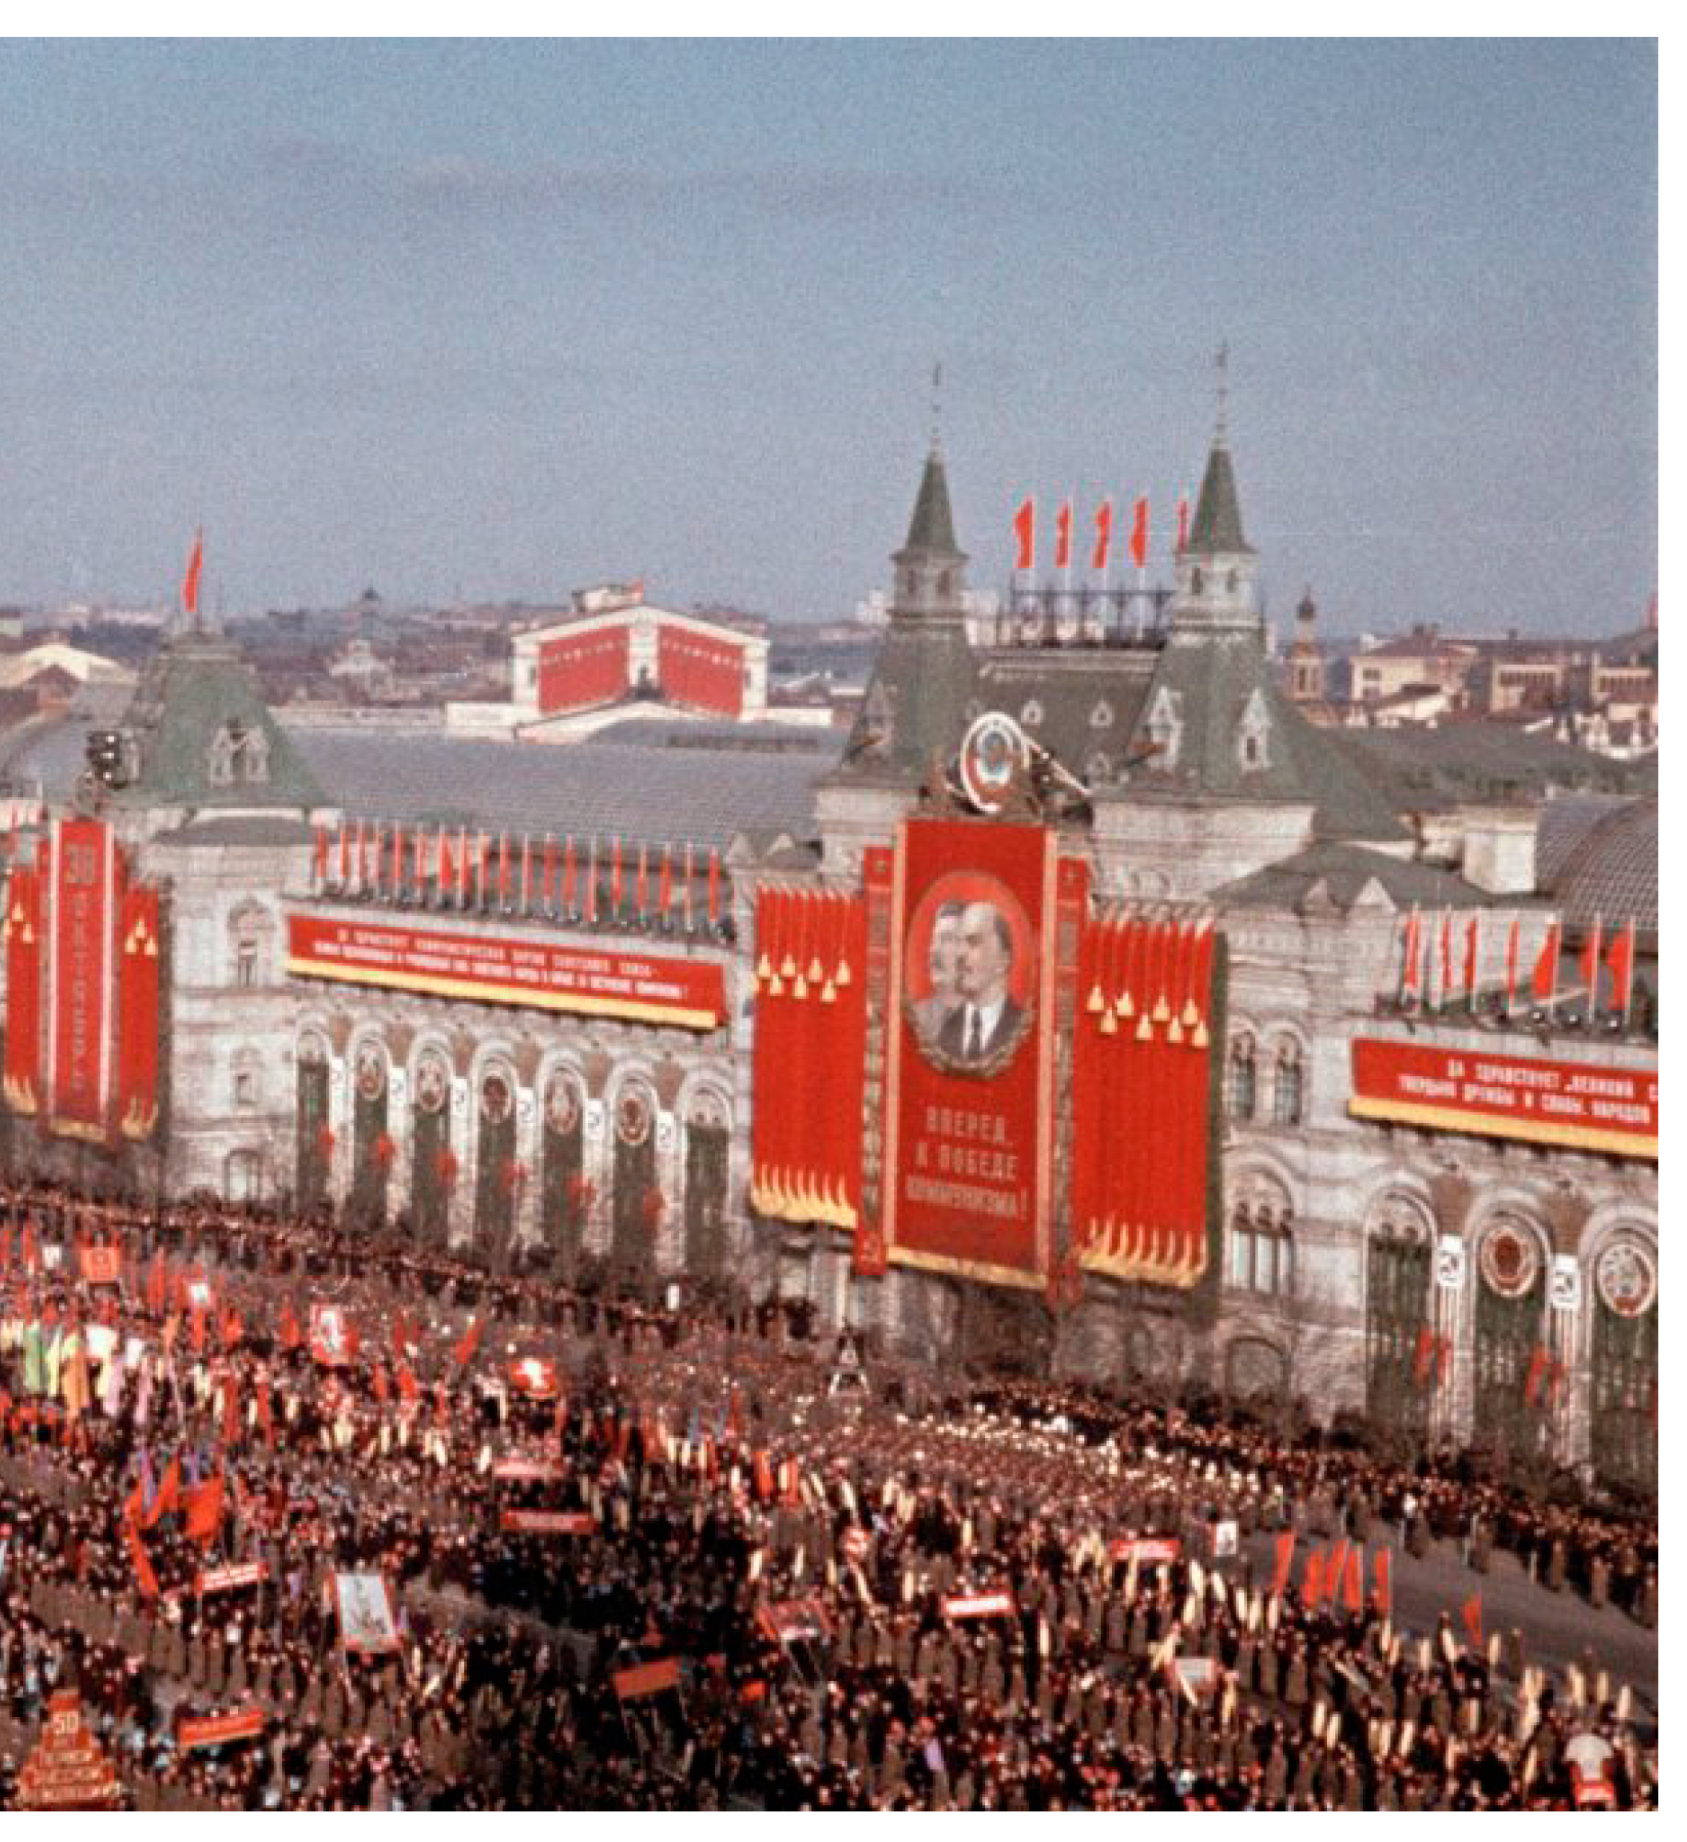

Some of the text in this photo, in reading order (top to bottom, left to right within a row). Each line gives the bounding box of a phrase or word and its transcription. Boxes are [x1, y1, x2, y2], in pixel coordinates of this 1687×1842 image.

[1448, 1059, 1465, 1079] ДА
[1475, 1063, 1560, 1090] ЗДРАВСТВУЕТ
[915, 1141, 1019, 1183] К ПОБЕДЕ
[907, 1175, 1029, 1223] КОММУНИЗМА!
[52, 1710, 80, 1735] 50
